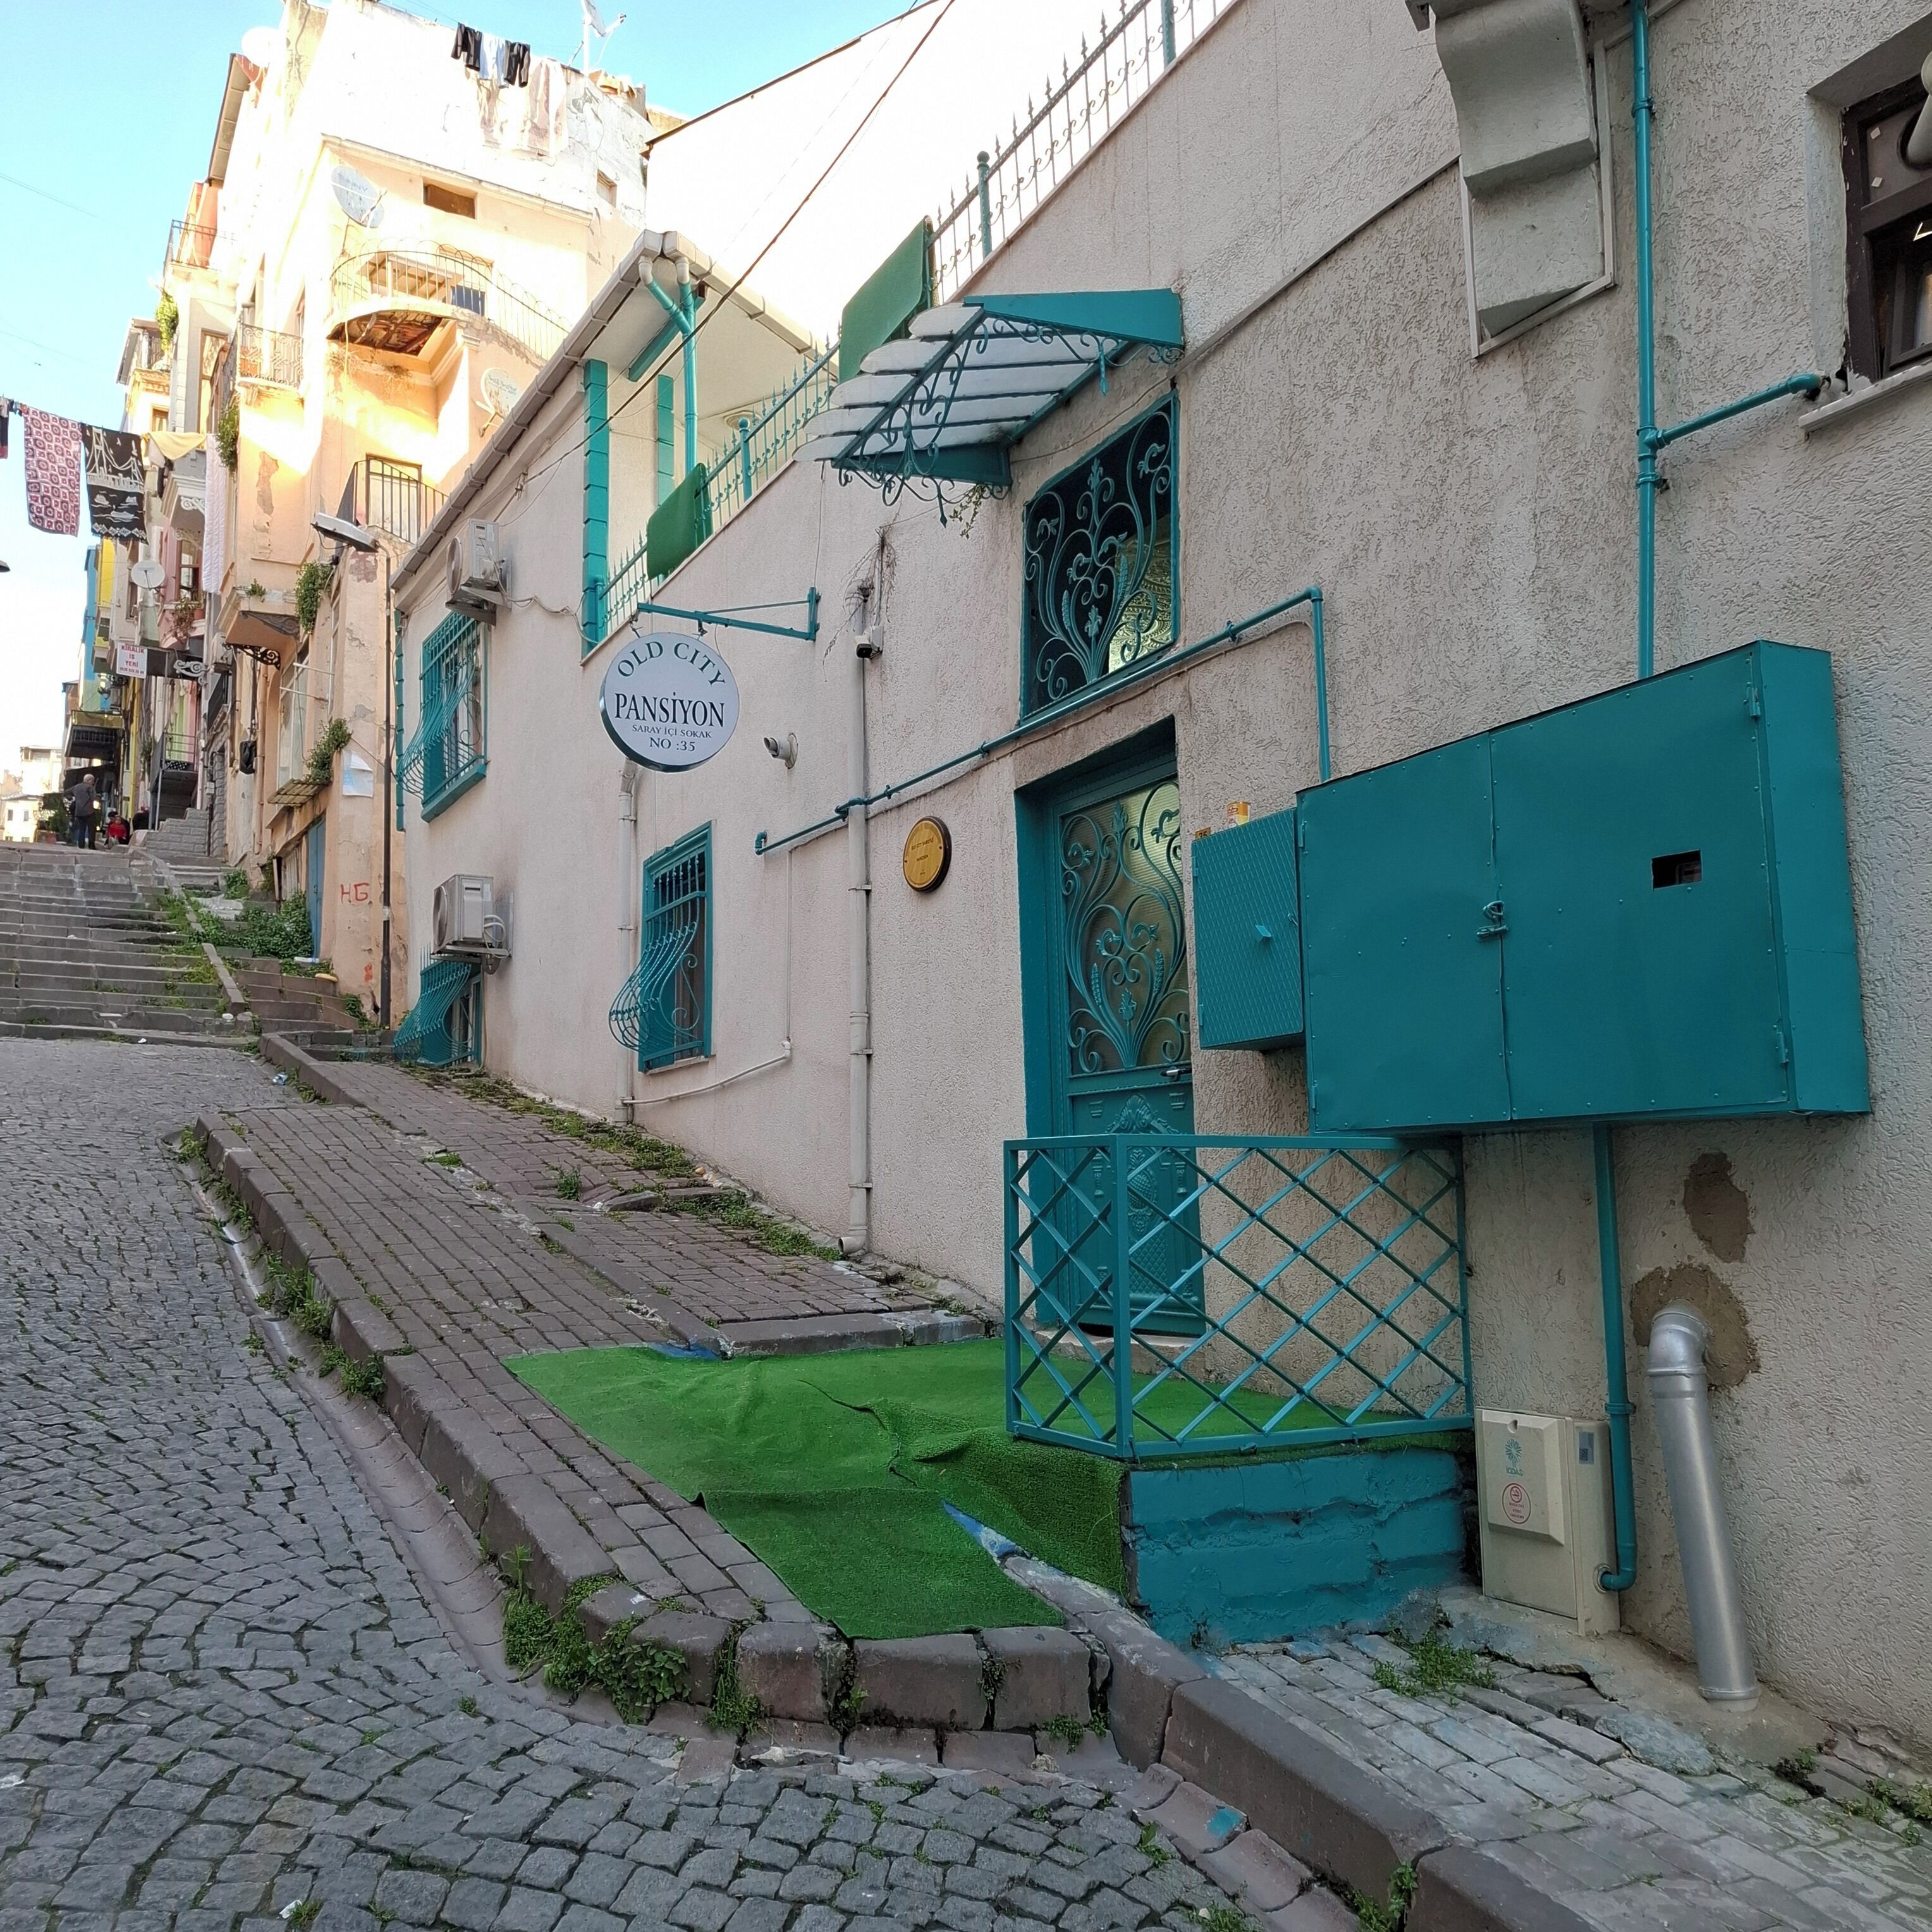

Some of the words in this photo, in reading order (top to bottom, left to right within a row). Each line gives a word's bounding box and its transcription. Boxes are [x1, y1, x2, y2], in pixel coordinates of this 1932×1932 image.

[617, 641, 664, 677] OLD
[673, 642, 726, 686] CITY
[614, 692, 725, 727] PANSİYON
[632, 724, 661, 734] SARAY
[664, 726, 677, 737] İÇİ
[680, 729, 712, 738] SOKAK
[649, 737, 671, 749] NO
